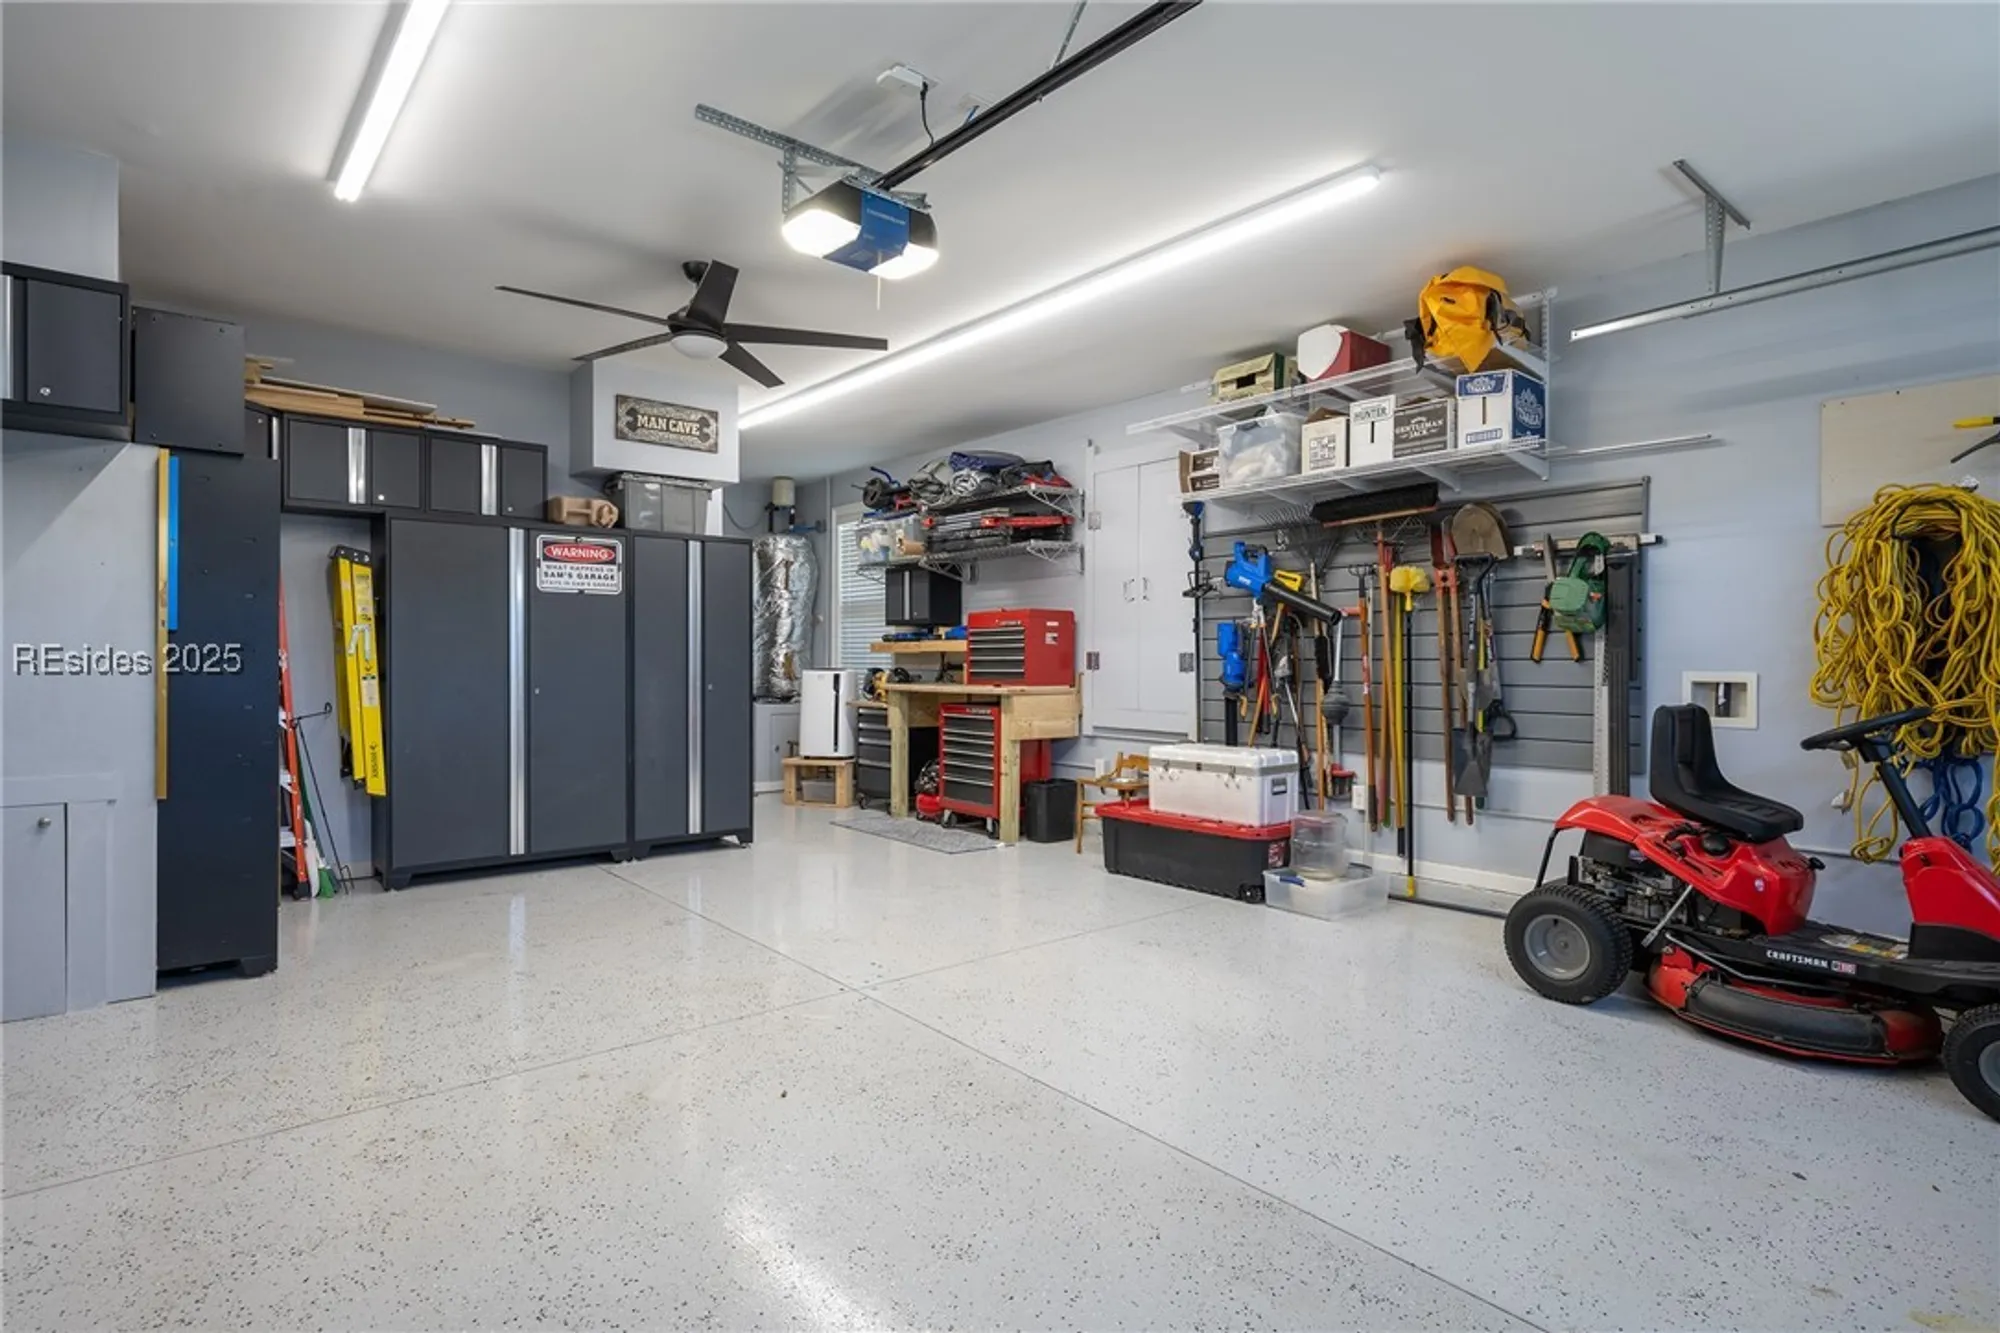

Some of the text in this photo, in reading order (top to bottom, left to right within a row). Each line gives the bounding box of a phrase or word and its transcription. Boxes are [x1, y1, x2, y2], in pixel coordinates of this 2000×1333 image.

[1353, 406, 1388, 420] HUNTER
[637, 415, 700, 435] MAN CAVE
[551, 546, 609, 559] WARNING
[543, 571, 615, 581] SAM'S GARAGE
[1766, 950, 1828, 967] CRAFTSMAN
